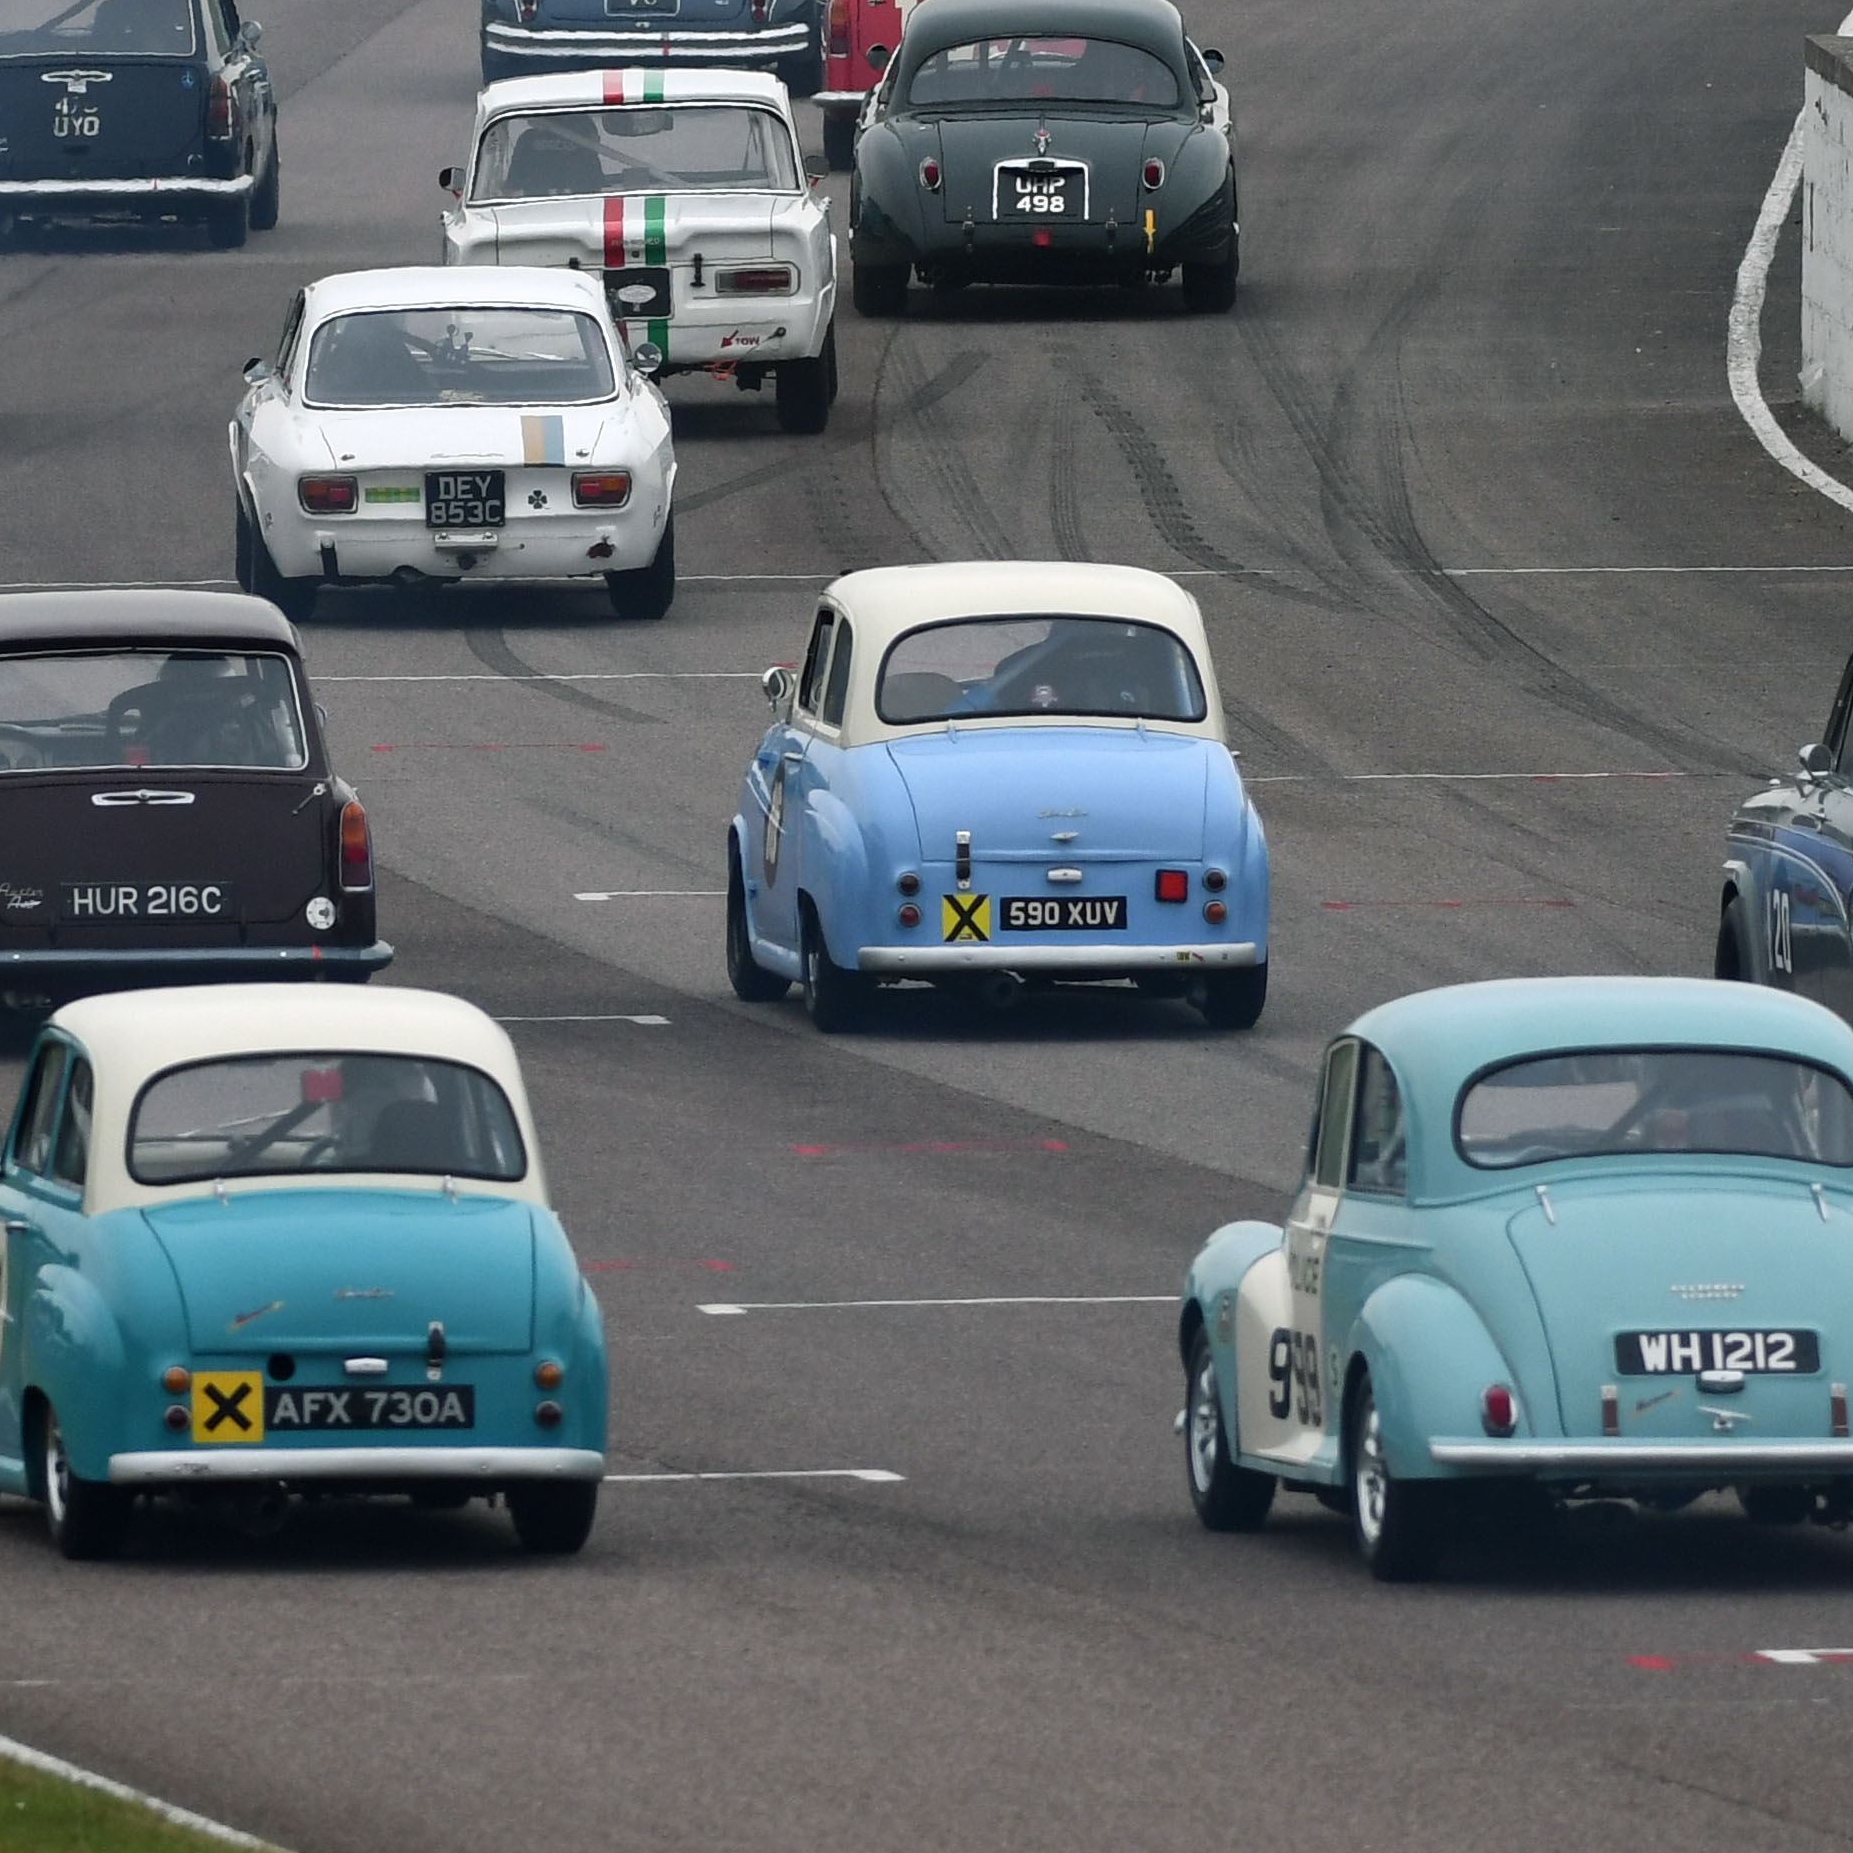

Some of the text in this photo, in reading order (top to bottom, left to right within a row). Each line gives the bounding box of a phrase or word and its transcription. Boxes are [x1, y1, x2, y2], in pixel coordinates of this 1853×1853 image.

[53, 115, 101, 138] UYO
[1015, 176, 1066, 194] UHP
[1015, 194, 1066, 214] 498
[736, 336, 760, 347] TOW
[438, 475, 493, 498] DEY
[430, 503, 501, 525] 853C
[73, 885, 222, 916] HUR 216C
[1009, 901, 1119, 926] 590 XUV
[1639, 1331, 1796, 1371] WH 1212
[1267, 1326, 1324, 1429] 999
[272, 1389, 466, 1427] AFX 730A
